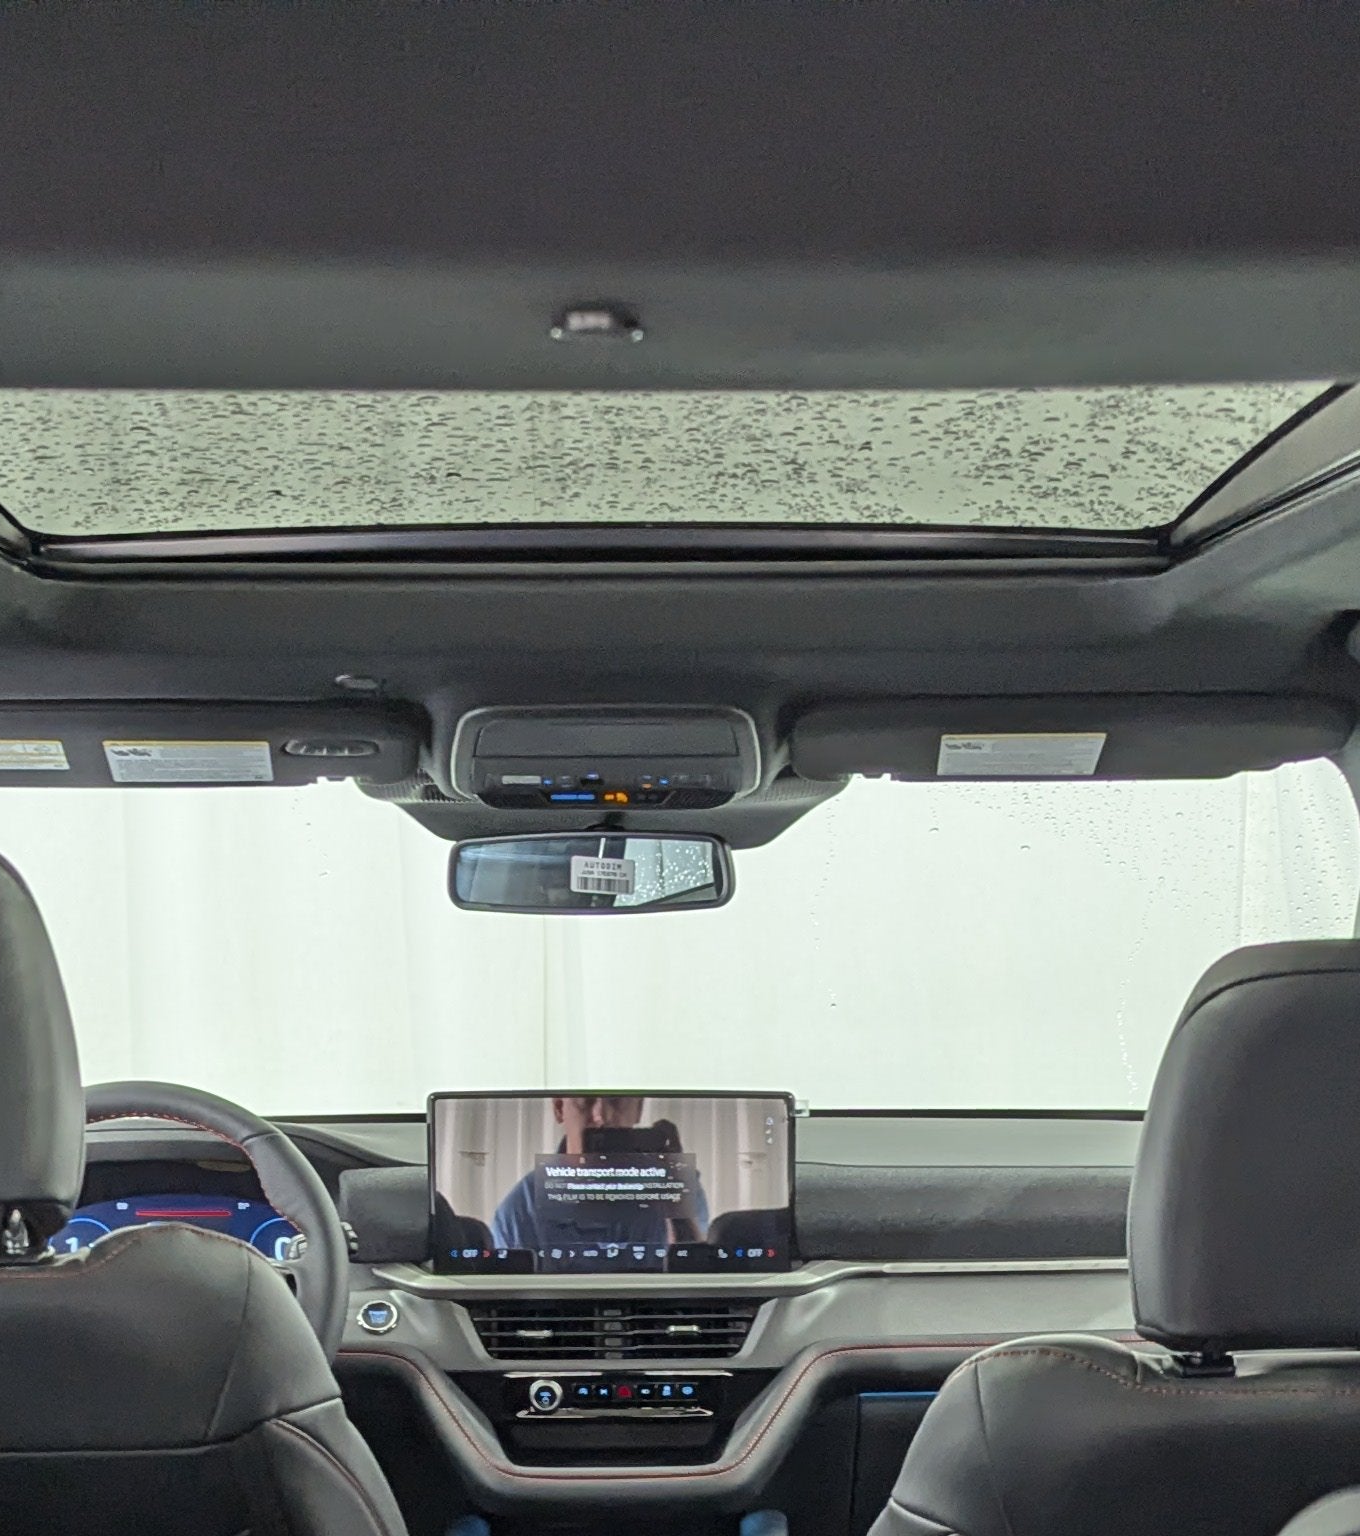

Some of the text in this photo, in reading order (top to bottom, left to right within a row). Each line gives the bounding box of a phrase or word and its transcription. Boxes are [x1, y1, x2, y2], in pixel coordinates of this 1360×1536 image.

[584, 862, 622, 870] AUTODIM
[545, 1166, 666, 1178] Vehicle transport mode active
